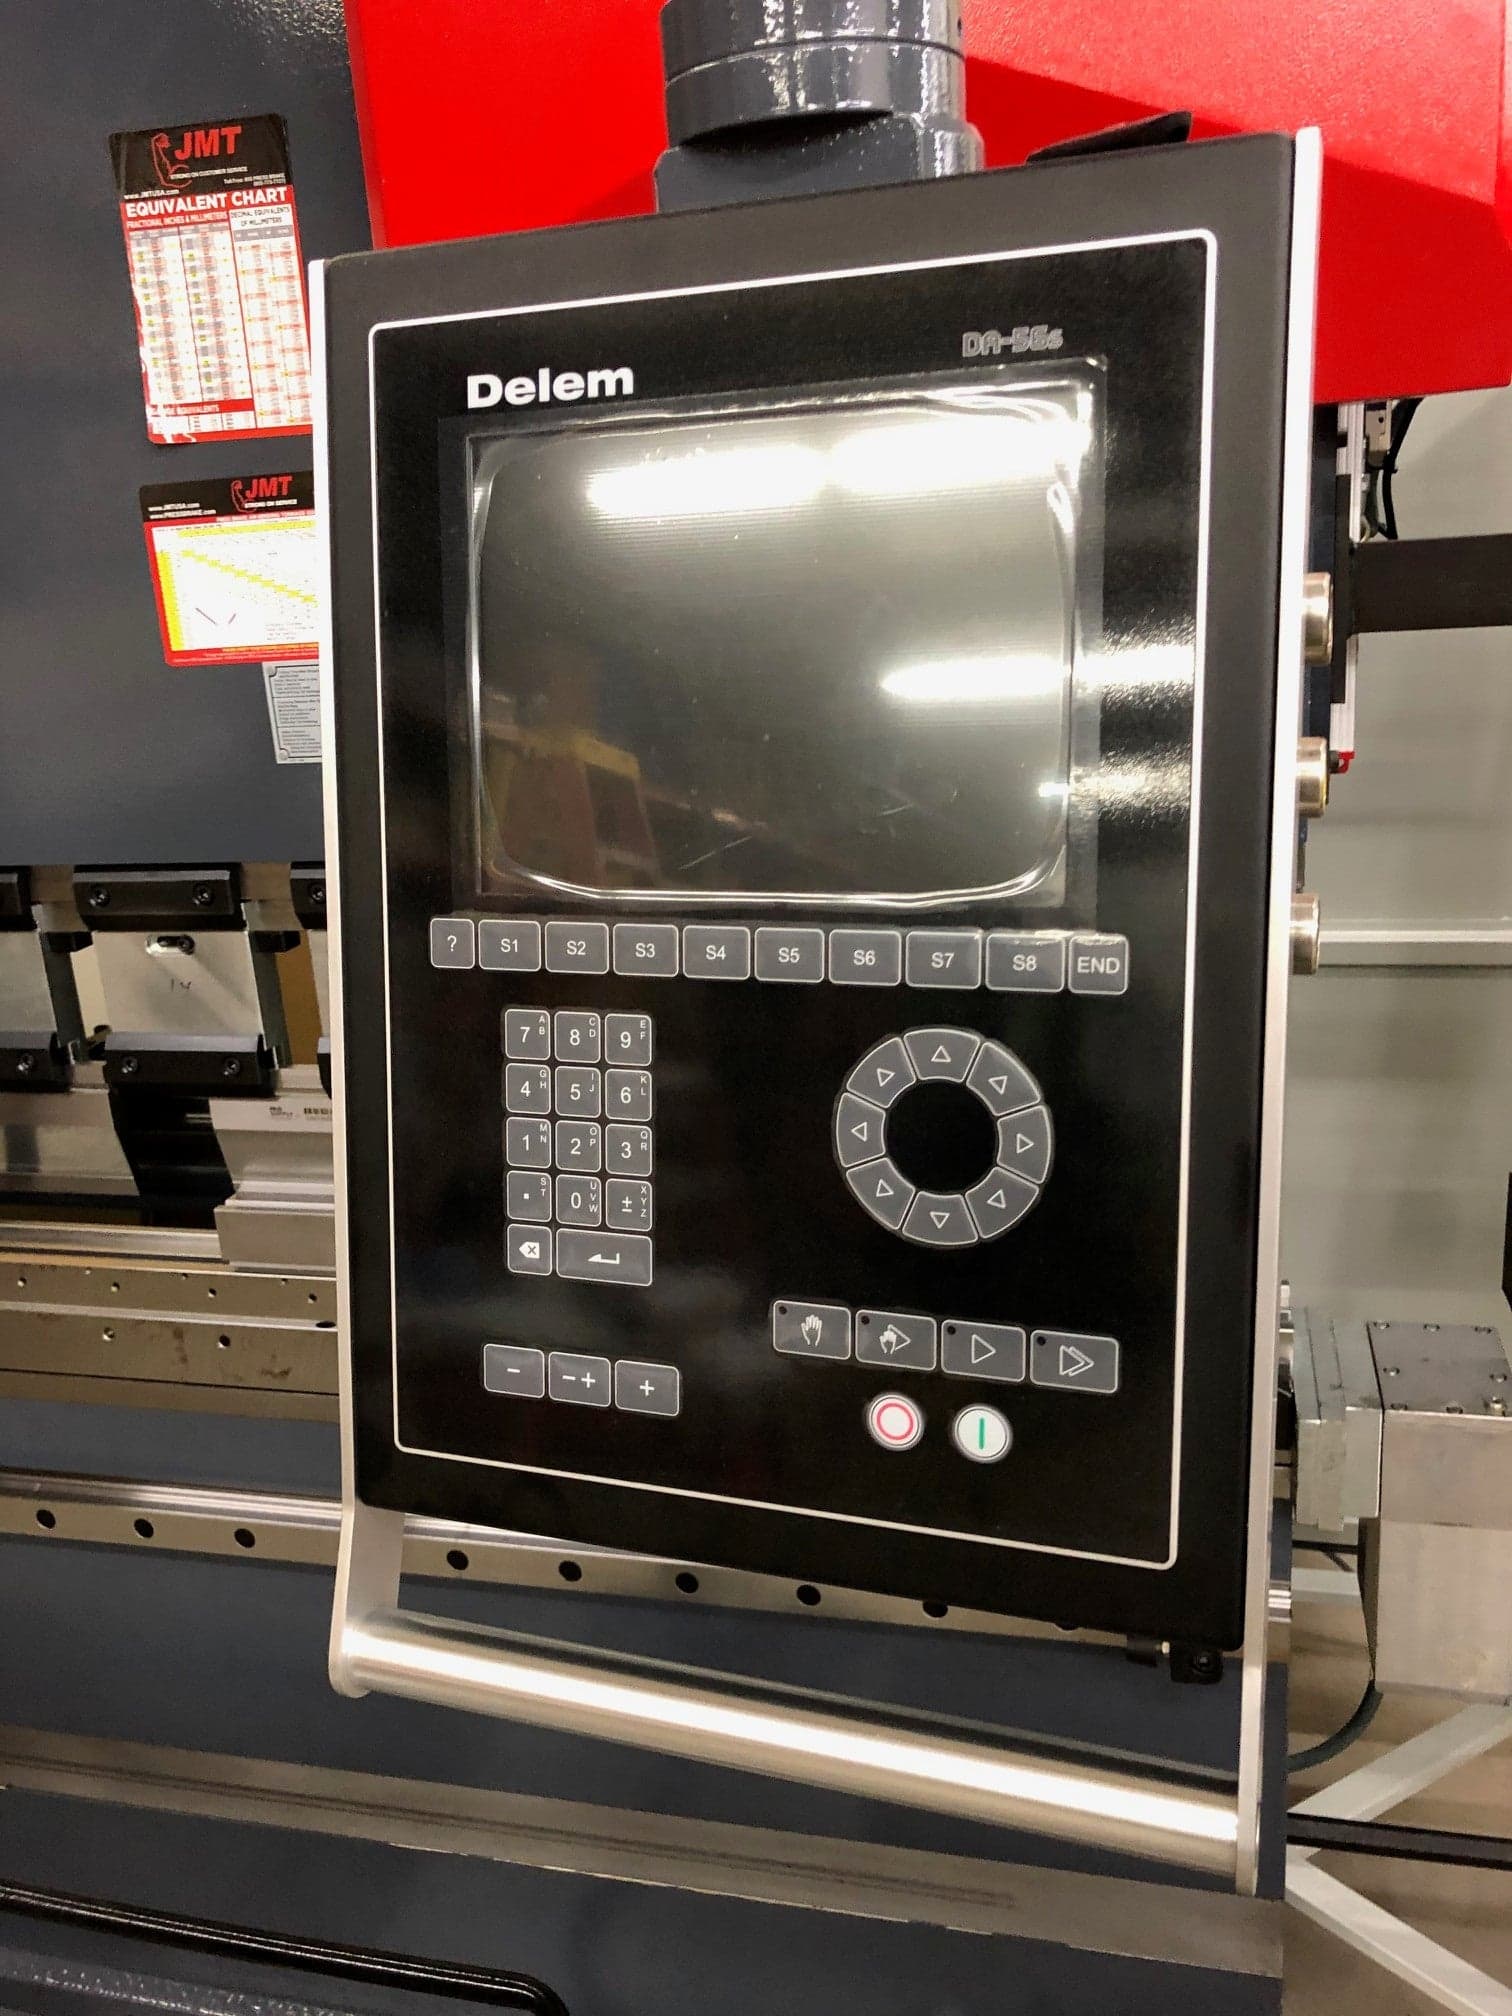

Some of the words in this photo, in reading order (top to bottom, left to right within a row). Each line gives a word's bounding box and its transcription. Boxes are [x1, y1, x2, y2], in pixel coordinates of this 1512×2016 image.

[175, 125, 242, 160] JMT
[126, 192, 231, 218] EQUIVALENT
[231, 186, 288, 206] CHART
[467, 367, 634, 409] Delem
[245, 476, 293, 498] JMT
[500, 939, 519, 953] S1
[566, 941, 586, 956] S2
[635, 942, 656, 958] S3
[705, 945, 727, 961] S4
[778, 947, 800, 963] S5
[853, 949, 876, 966] S6
[931, 952, 955, 969] S7
[1012, 955, 1038, 972] S8
[1077, 957, 1120, 974] END
[538, 1015, 546, 1024] A
[589, 1018, 596, 1026] C
[640, 1020, 646, 1028] E
[520, 1026, 531, 1043] 7
[538, 1027, 545, 1035] B
[569, 1029, 580, 1046] 8
[589, 1029, 596, 1038] D
[640, 1032, 646, 1040] F
[620, 1031, 631, 1049] 9
[539, 1070, 547, 1078] G
[640, 1075, 647, 1084] K
[520, 1081, 531, 1098] 4
[540, 1081, 547, 1089] H
[570, 1083, 581, 1100] 5
[589, 1084, 595, 1092] J
[640, 1088, 646, 1096] L
[620, 1086, 631, 1104] 6
[540, 1124, 547, 1132] M
[522, 1134, 530, 1151] 1
[540, 1135, 547, 1144] N
[640, 1131, 648, 1140] Q
[570, 1138, 581, 1155] 2
[589, 1139, 597, 1147] P
[621, 1142, 632, 1159] 3
[540, 1188, 547, 1196] T
[590, 1182, 597, 1190] U
[640, 1186, 647, 1194] X
[570, 1192, 582, 1209] 0
[590, 1193, 597, 1201] V
[589, 1205, 598, 1213] W
[640, 1210, 647, 1218] Z
